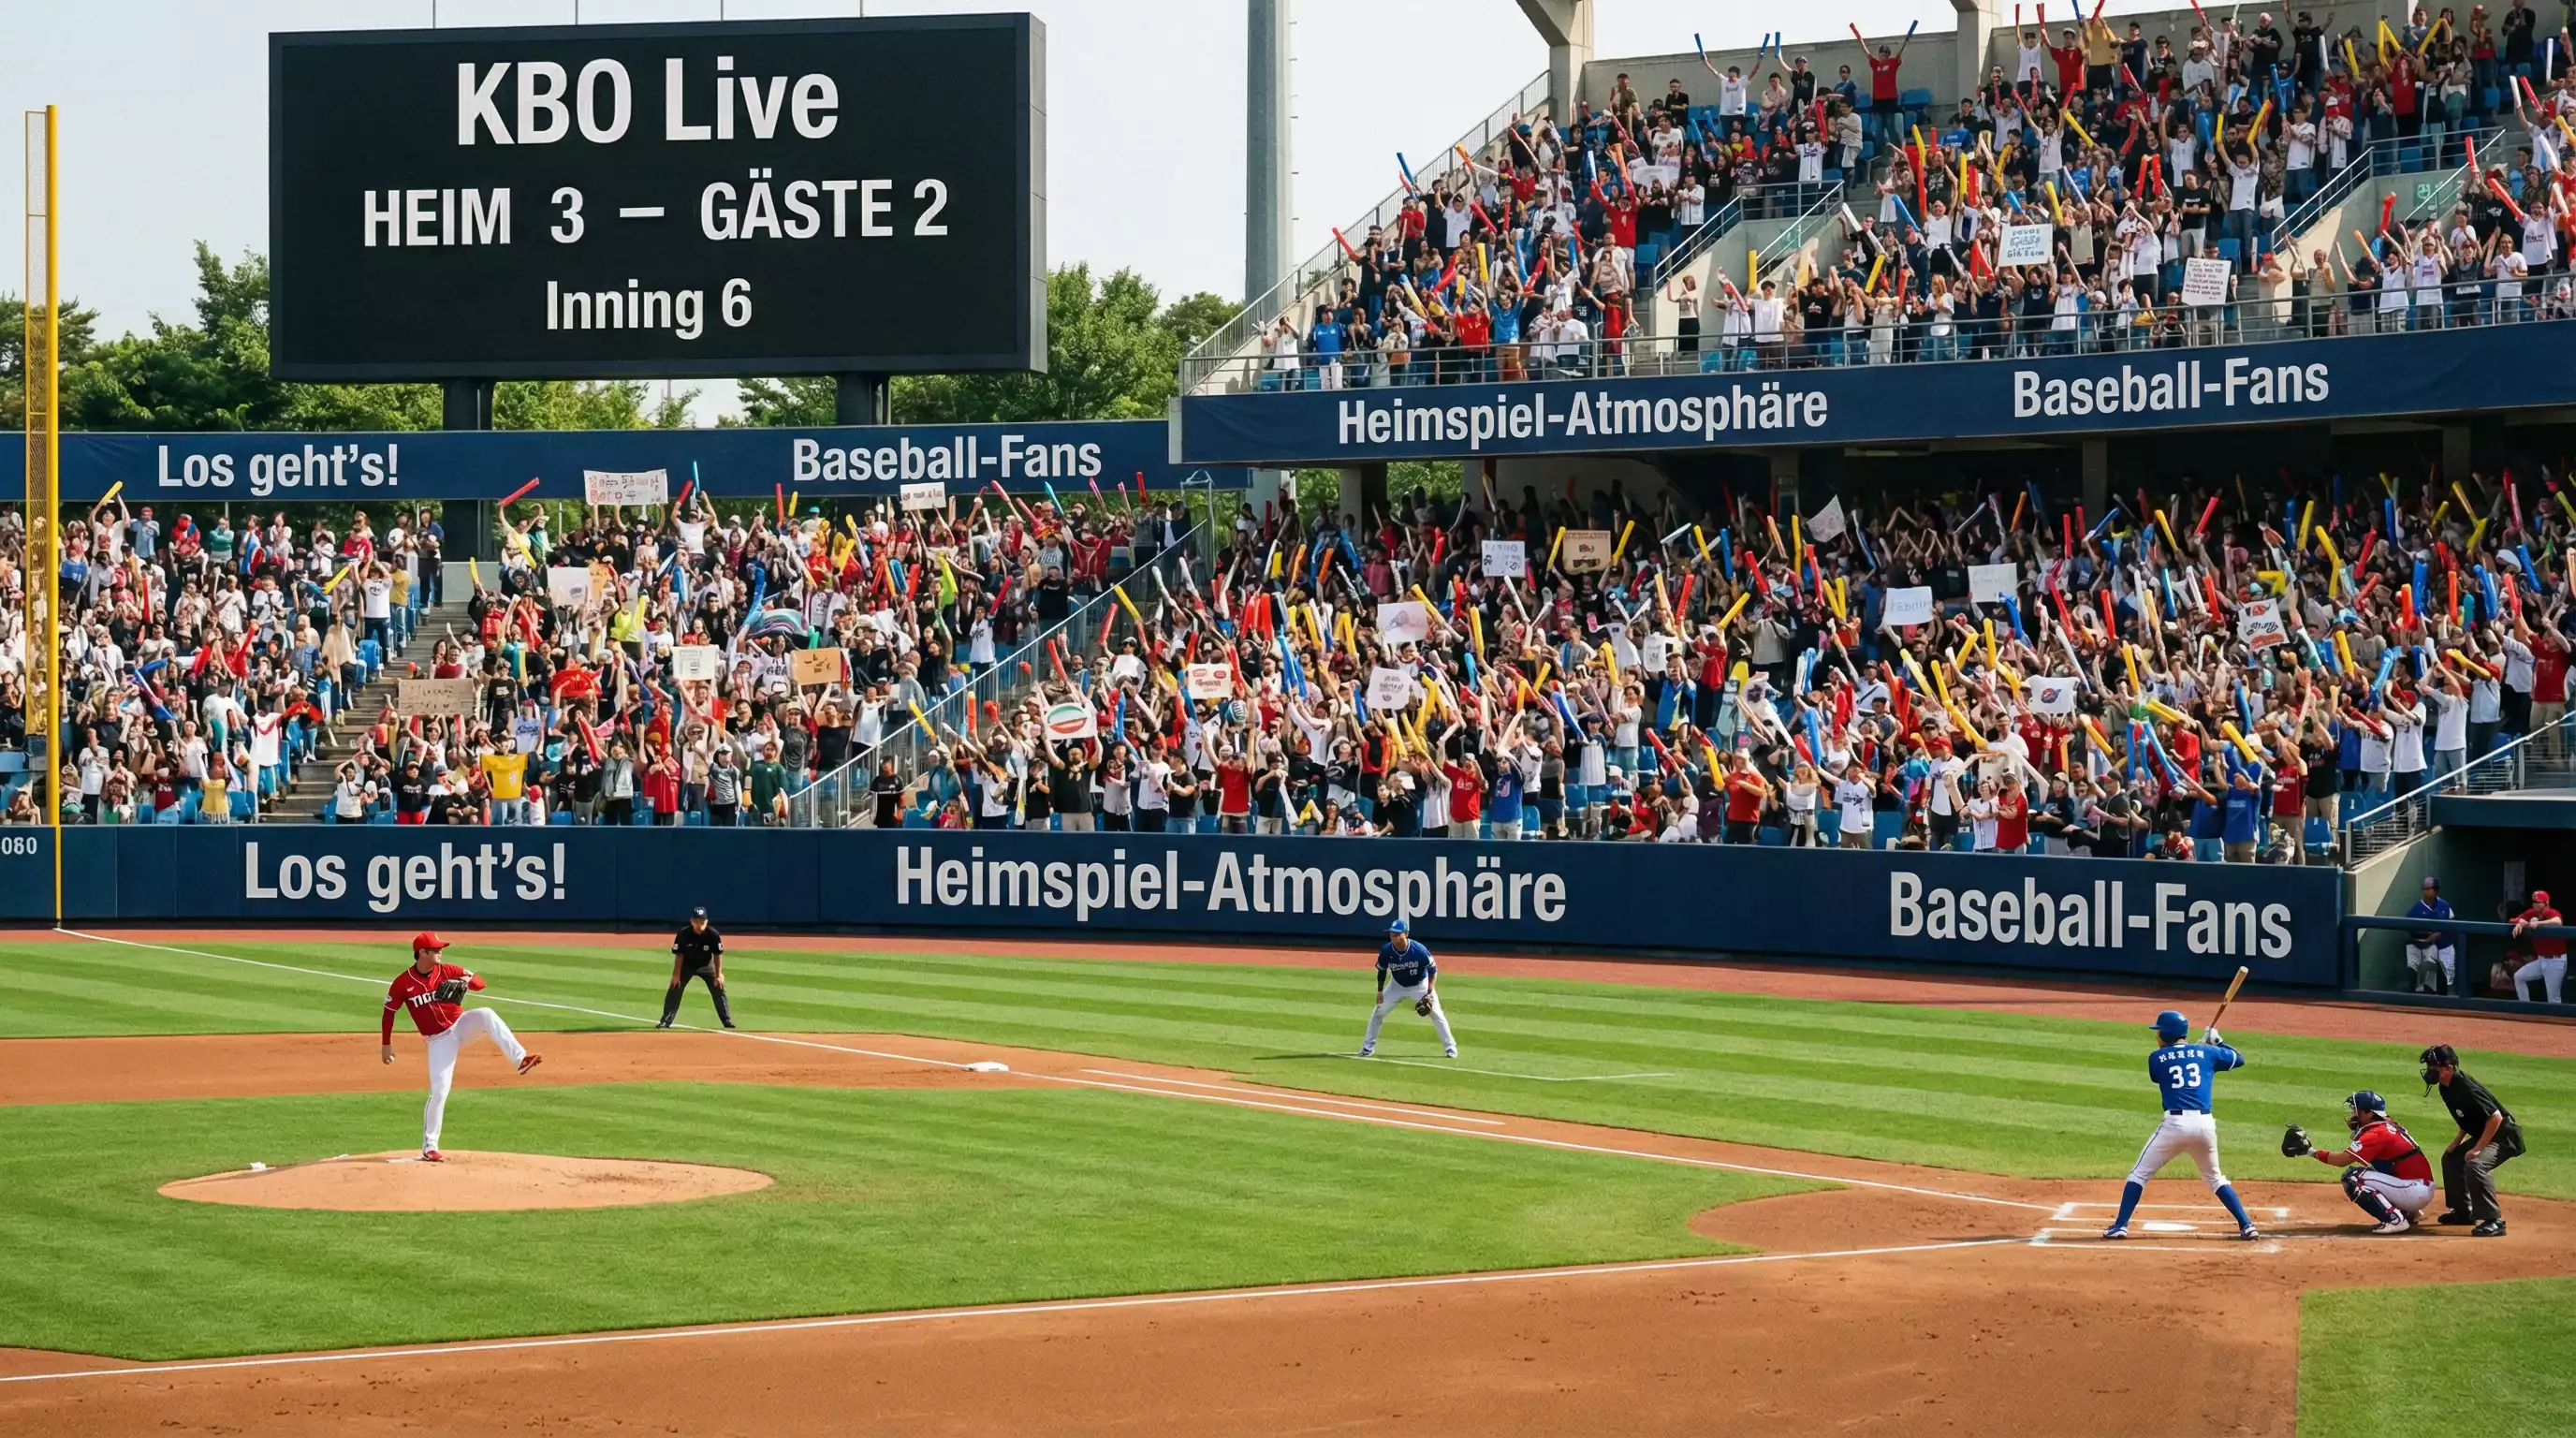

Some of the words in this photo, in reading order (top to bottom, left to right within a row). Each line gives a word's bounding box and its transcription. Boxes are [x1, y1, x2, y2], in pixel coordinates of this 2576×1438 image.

[458, 58, 632, 146] KBO
[666, 55, 839, 141] Live
[364, 188, 511, 247] HEIM
[550, 186, 585, 243] 3
[700, 168, 893, 241] GÄSTE
[914, 178, 948, 236] 2
[547, 277, 704, 340] Inning
[722, 277, 753, 328] 6
[1339, 381, 1828, 450] Heimspiel-Atmosphäre
[2014, 357, 2329, 418] Baseball-Fans
[158, 445, 235, 488] Los
[249, 443, 398, 497] geht’s!
[793, 434, 1102, 481] Baseball-Fans
[245, 842, 346, 900] Los
[367, 842, 565, 913] geht’s!
[897, 845, 1566, 931] Heimspiel-Atmosphäre
[1891, 871, 2292, 959] Baseball-Fans
[2169, 1063, 2202, 1089] 33
